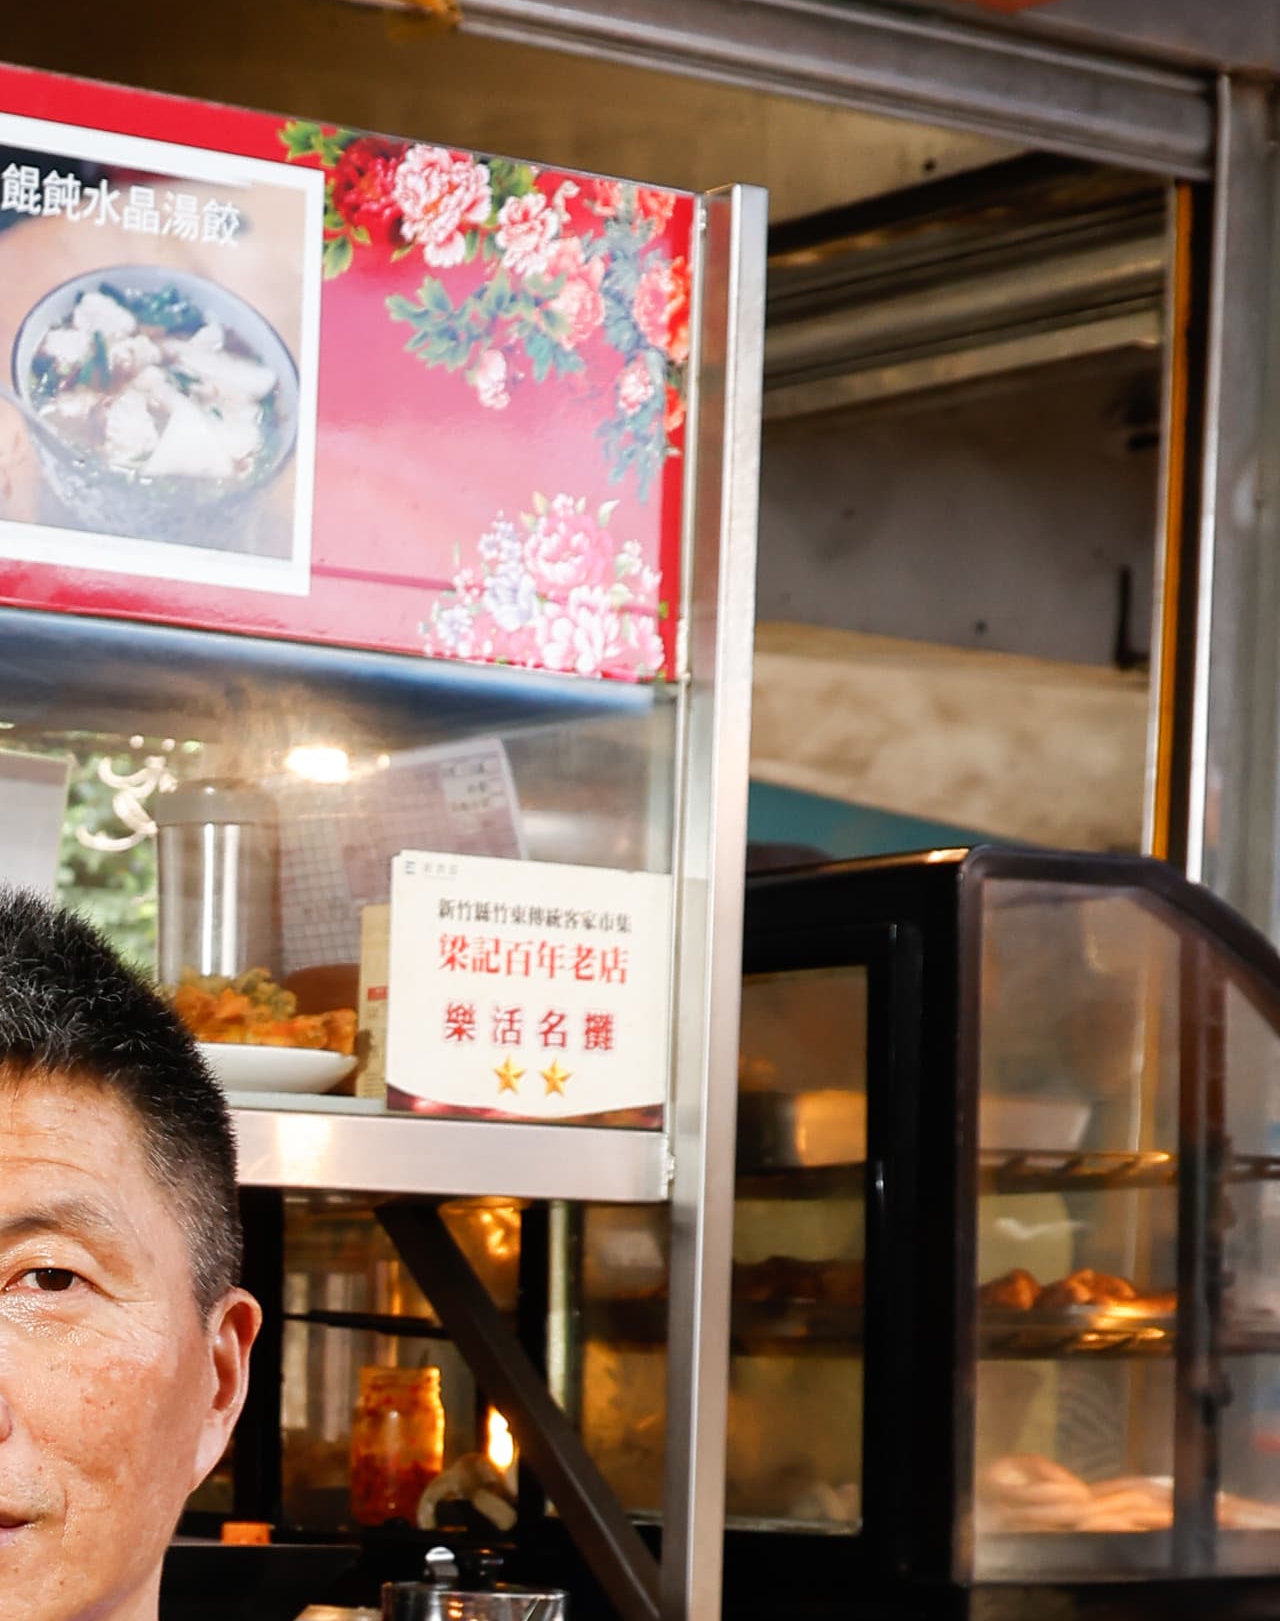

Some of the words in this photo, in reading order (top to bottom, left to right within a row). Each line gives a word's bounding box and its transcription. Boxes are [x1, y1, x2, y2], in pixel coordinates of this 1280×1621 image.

[0, 162, 241, 248] 餛飩水晶湯餃
[438, 931, 630, 985] 梁記百年老店
[443, 1001, 616, 1052] 樂活名攤
